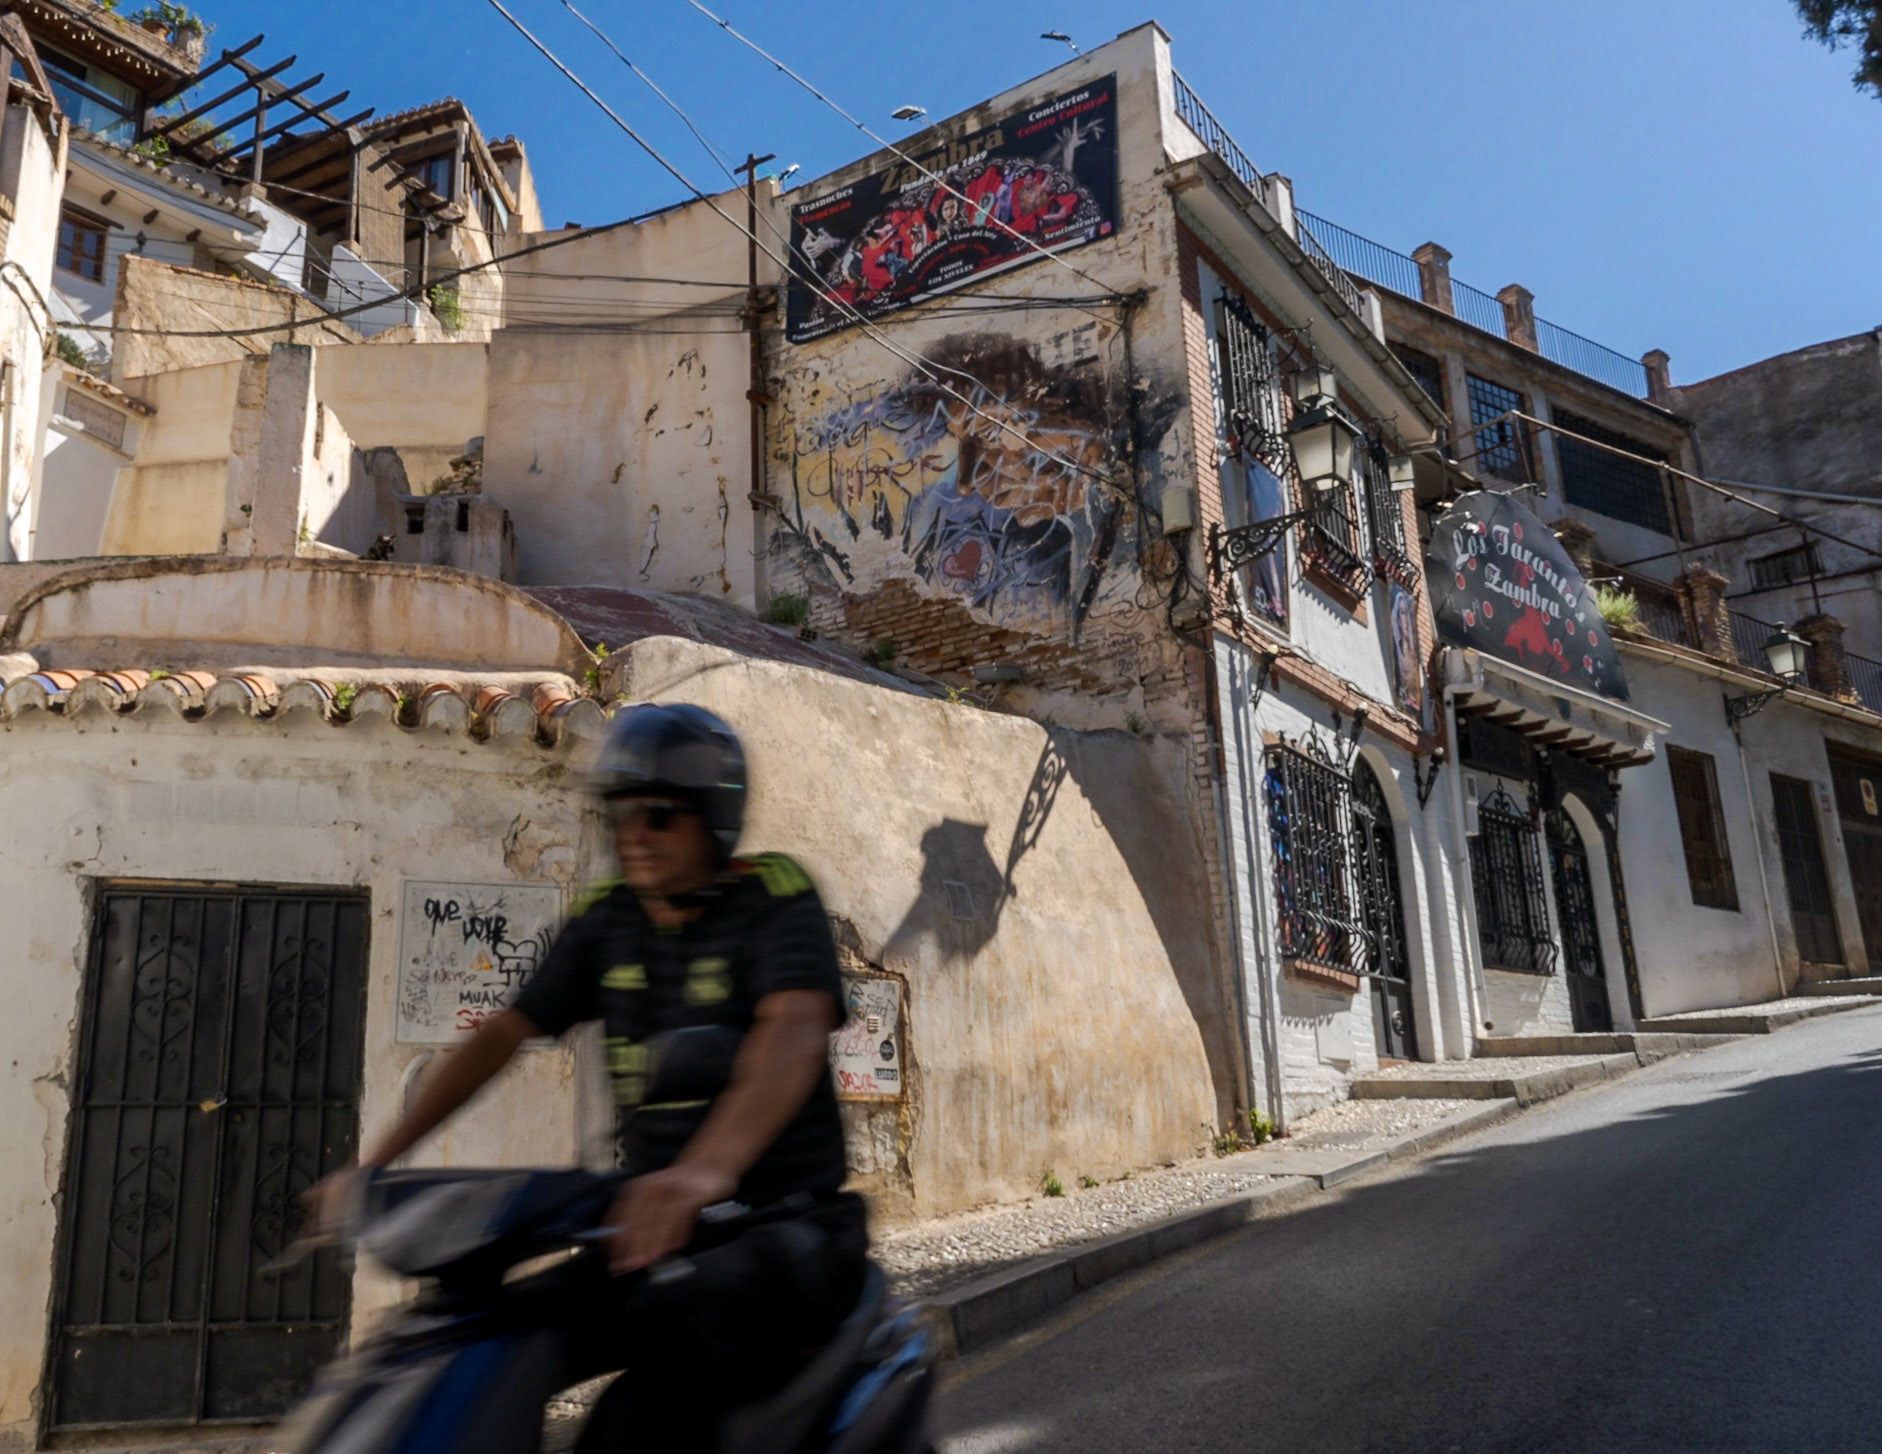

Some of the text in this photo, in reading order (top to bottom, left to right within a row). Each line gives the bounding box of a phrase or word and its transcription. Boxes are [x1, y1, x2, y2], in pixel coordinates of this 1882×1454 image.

[1017, 91, 1109, 138] Centro Cultural
[1028, 90, 1090, 122] Conciertos
[880, 129, 1005, 195] Zambra
[946, 163, 959, 175] en
[800, 187, 853, 214] Trasnoches
[1044, 215, 1101, 240] Sentimiento
[939, 260, 963, 274] TODOS
[943, 263, 974, 280] NIVELES
[1453, 524, 1586, 624] Los Tarantos
[1484, 562, 1561, 619] Zambra
